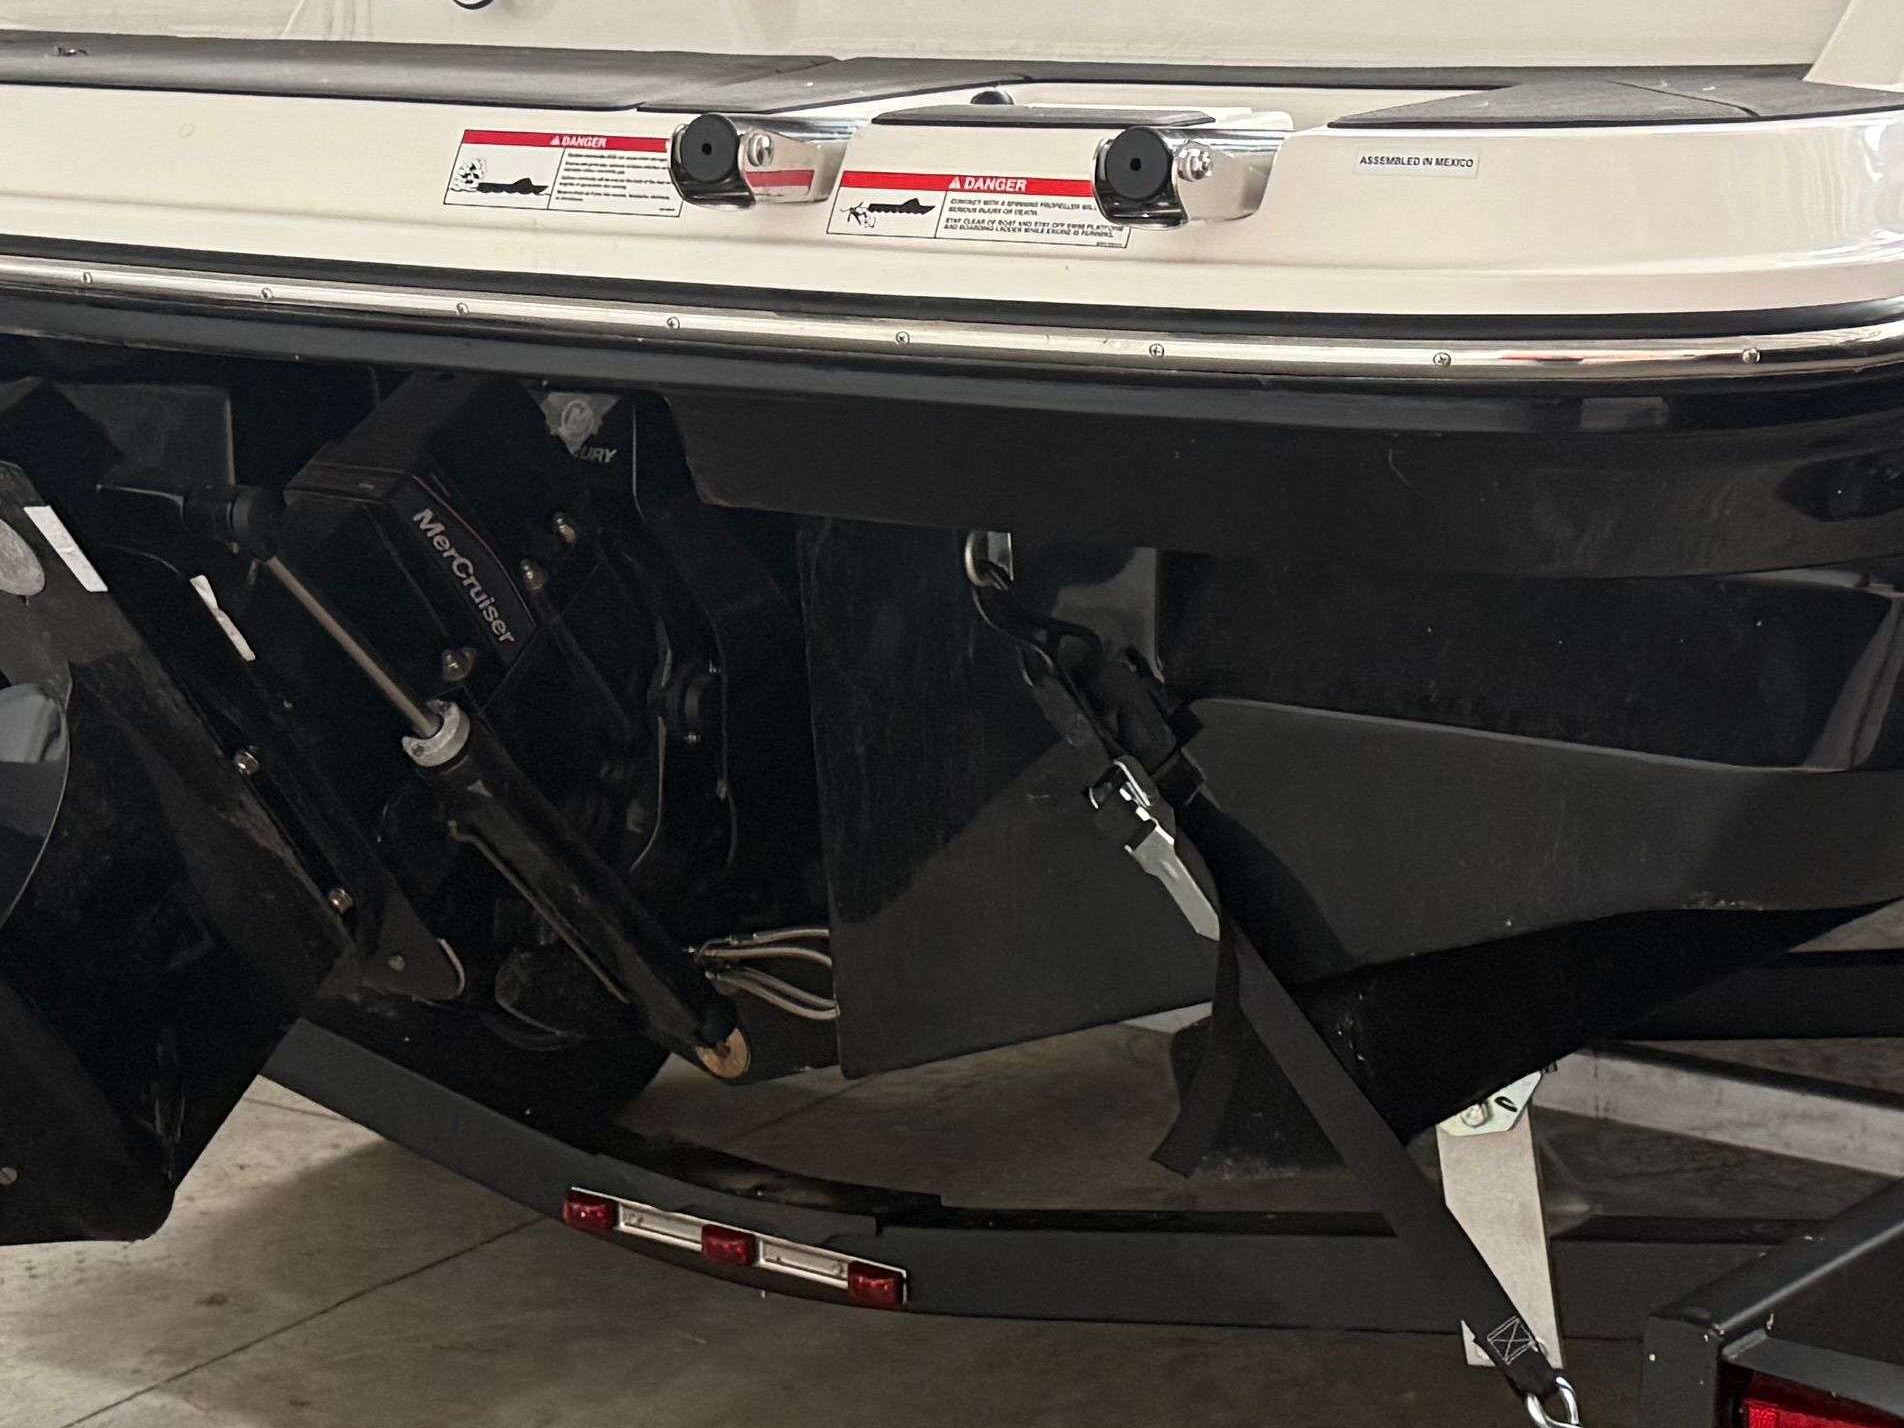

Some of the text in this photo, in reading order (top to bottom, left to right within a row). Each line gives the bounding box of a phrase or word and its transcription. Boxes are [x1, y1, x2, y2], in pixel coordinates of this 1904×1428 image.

[561, 136, 607, 148] DANGER
[1360, 156, 1474, 168] ASSEMBLED IN MEXICO
[964, 176, 1027, 192] DANGER
[413, 509, 515, 642] MerCruiser
